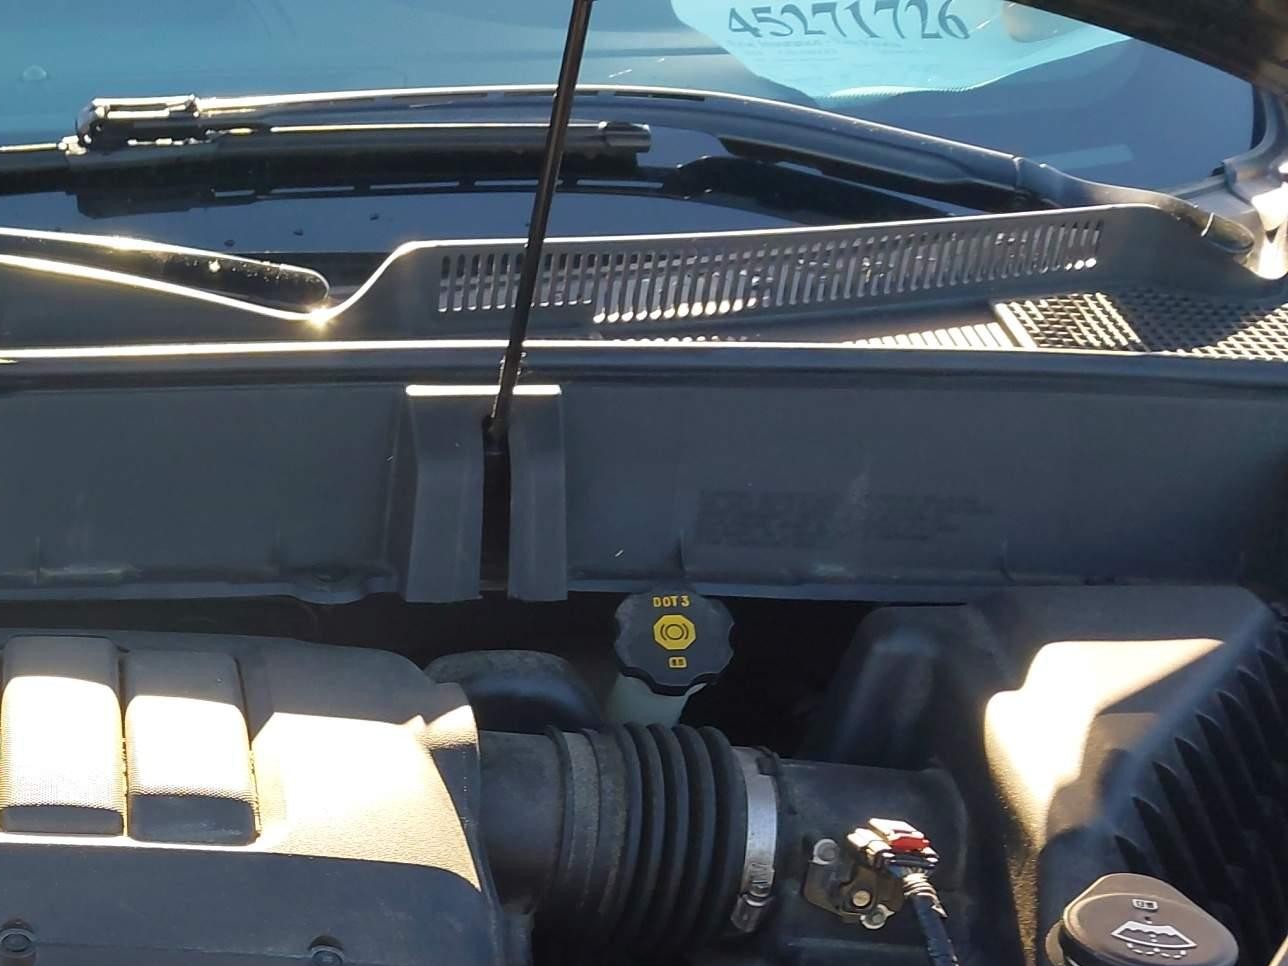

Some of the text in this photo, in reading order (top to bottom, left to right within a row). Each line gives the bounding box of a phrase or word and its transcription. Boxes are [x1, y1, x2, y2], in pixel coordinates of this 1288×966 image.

[729, 0, 970, 39] 45271726
[652, 595, 690, 608] DOT 3
